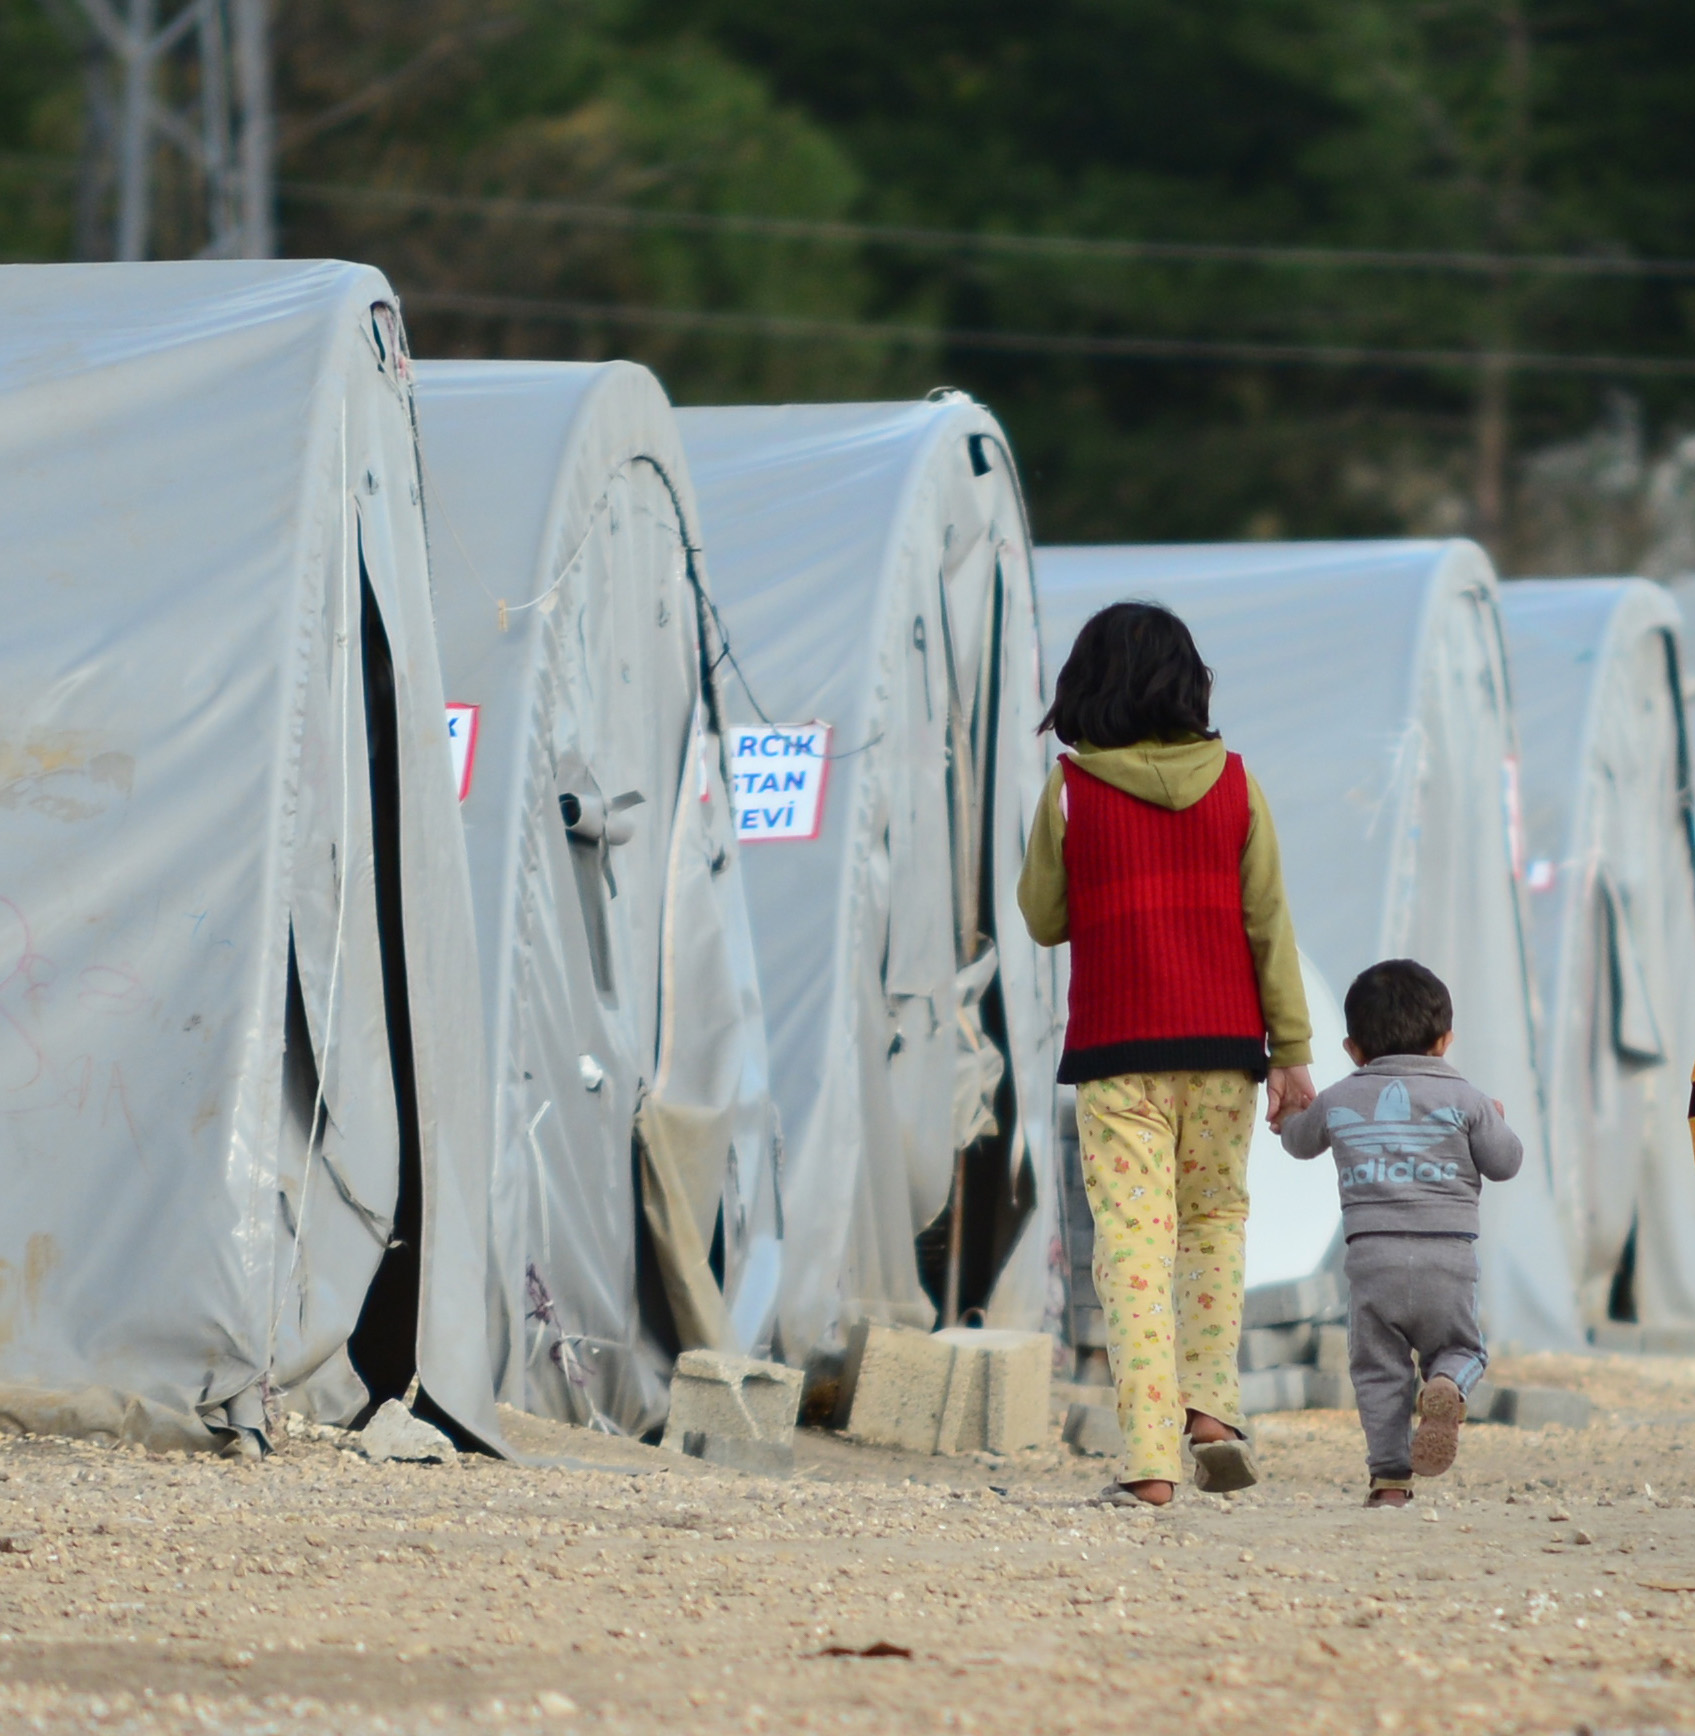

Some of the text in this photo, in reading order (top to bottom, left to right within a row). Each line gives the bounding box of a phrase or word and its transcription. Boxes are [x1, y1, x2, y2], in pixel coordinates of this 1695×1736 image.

[731, 735, 815, 757] RCIK
[738, 801, 796, 830] EVİ
[1340, 1156, 1459, 1188] adidas
